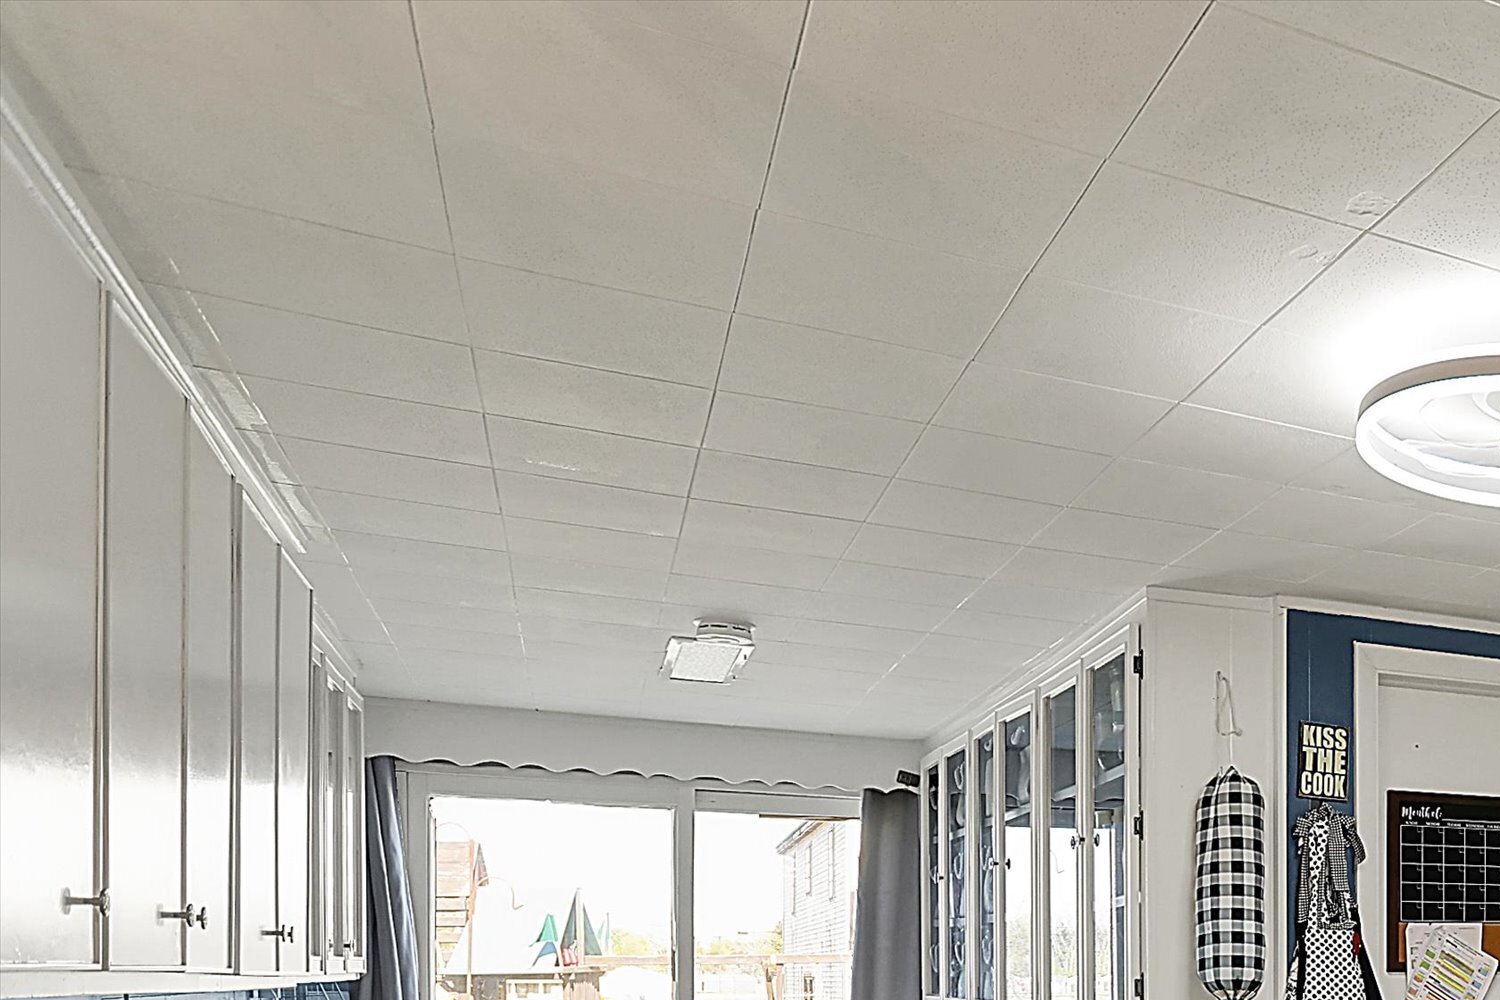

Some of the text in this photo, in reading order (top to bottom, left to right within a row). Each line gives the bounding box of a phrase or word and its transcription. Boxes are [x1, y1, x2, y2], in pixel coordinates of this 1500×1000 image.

[1303, 724, 1347, 750] KISS
[1302, 746, 1346, 775] THE
[1301, 771, 1345, 798] COOK
